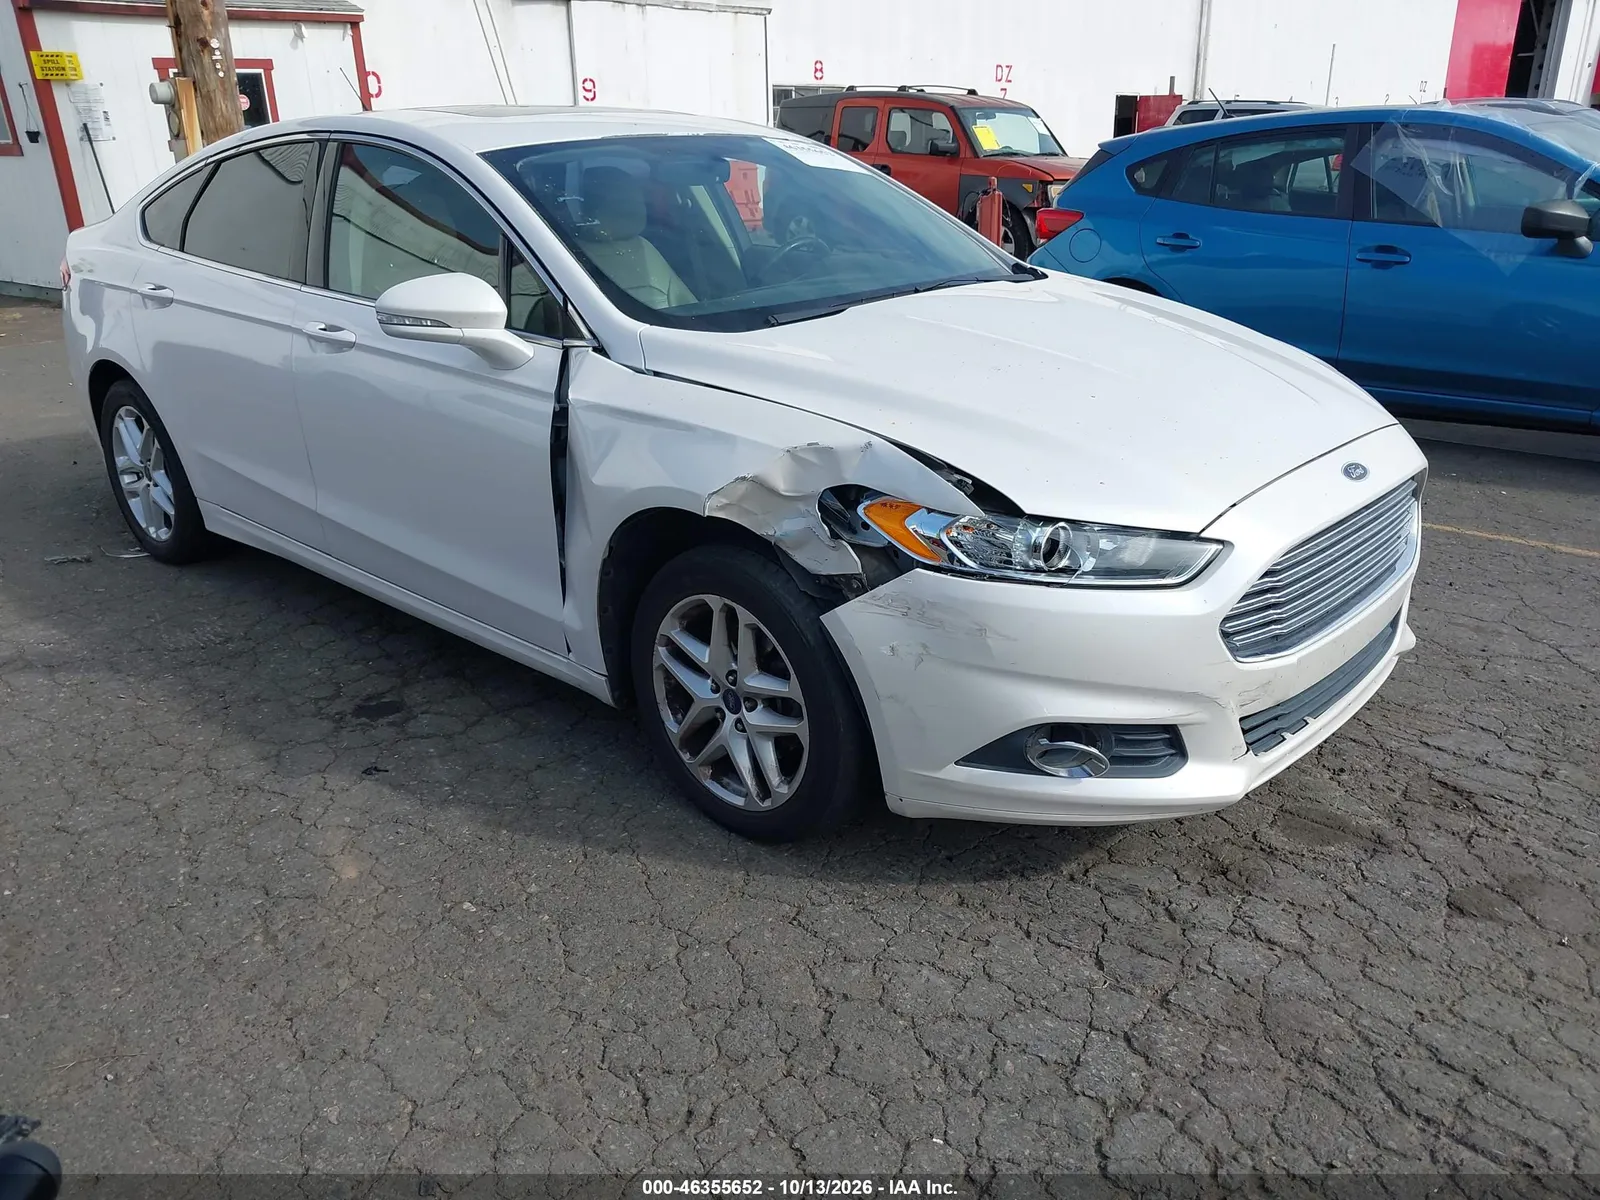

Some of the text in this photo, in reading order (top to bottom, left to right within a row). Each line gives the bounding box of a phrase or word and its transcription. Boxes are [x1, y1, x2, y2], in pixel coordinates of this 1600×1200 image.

[814, 60, 824, 81] 8
[995, 64, 1013, 83] DZ
[582, 78, 596, 102] 9
